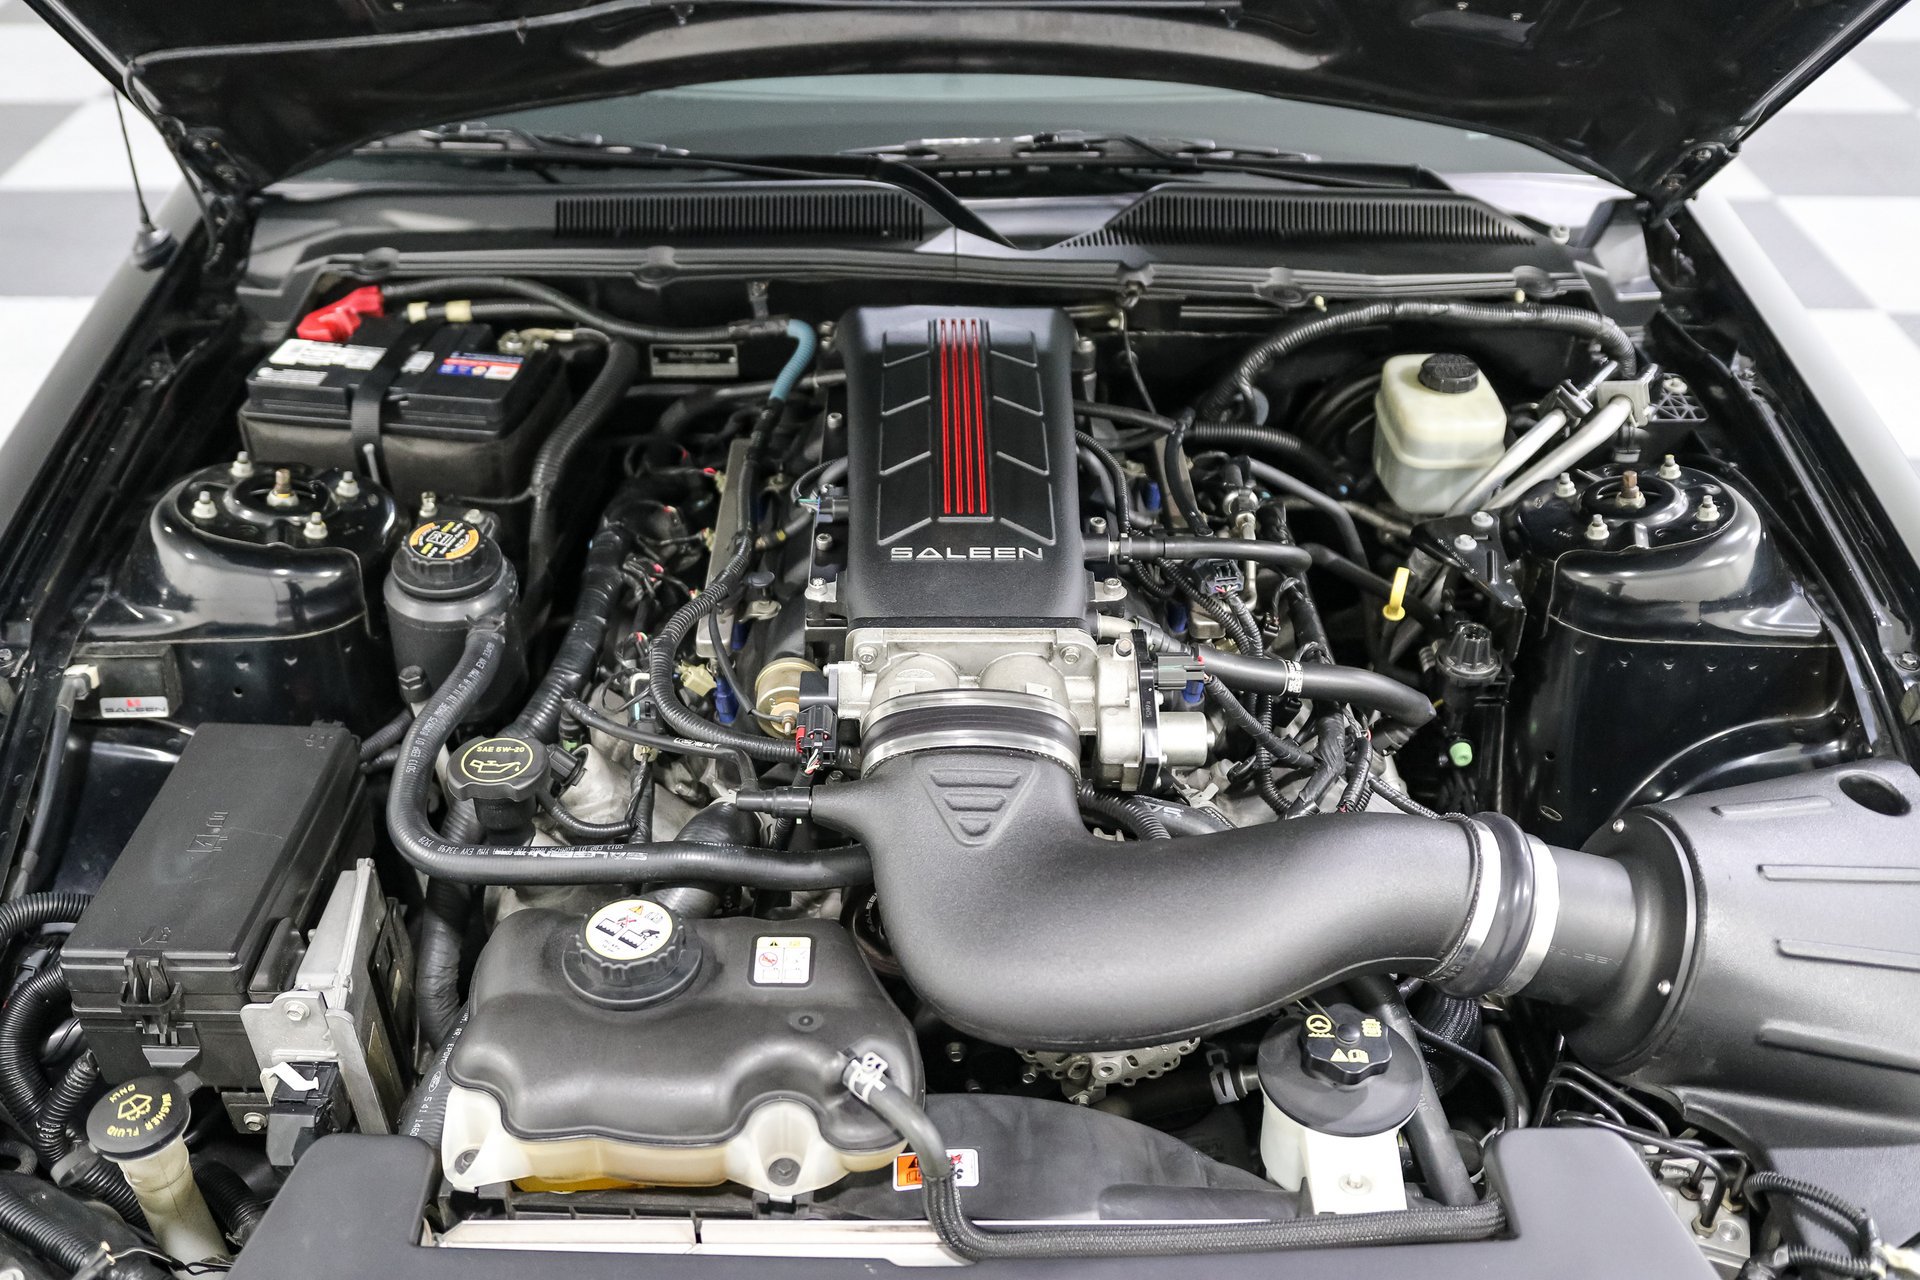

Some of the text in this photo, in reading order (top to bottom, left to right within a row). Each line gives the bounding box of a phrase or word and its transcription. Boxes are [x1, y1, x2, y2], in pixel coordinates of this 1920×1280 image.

[890, 547, 1043, 561] SALEEN
[106, 1083, 172, 1138] WASHER FLUID ONLY
